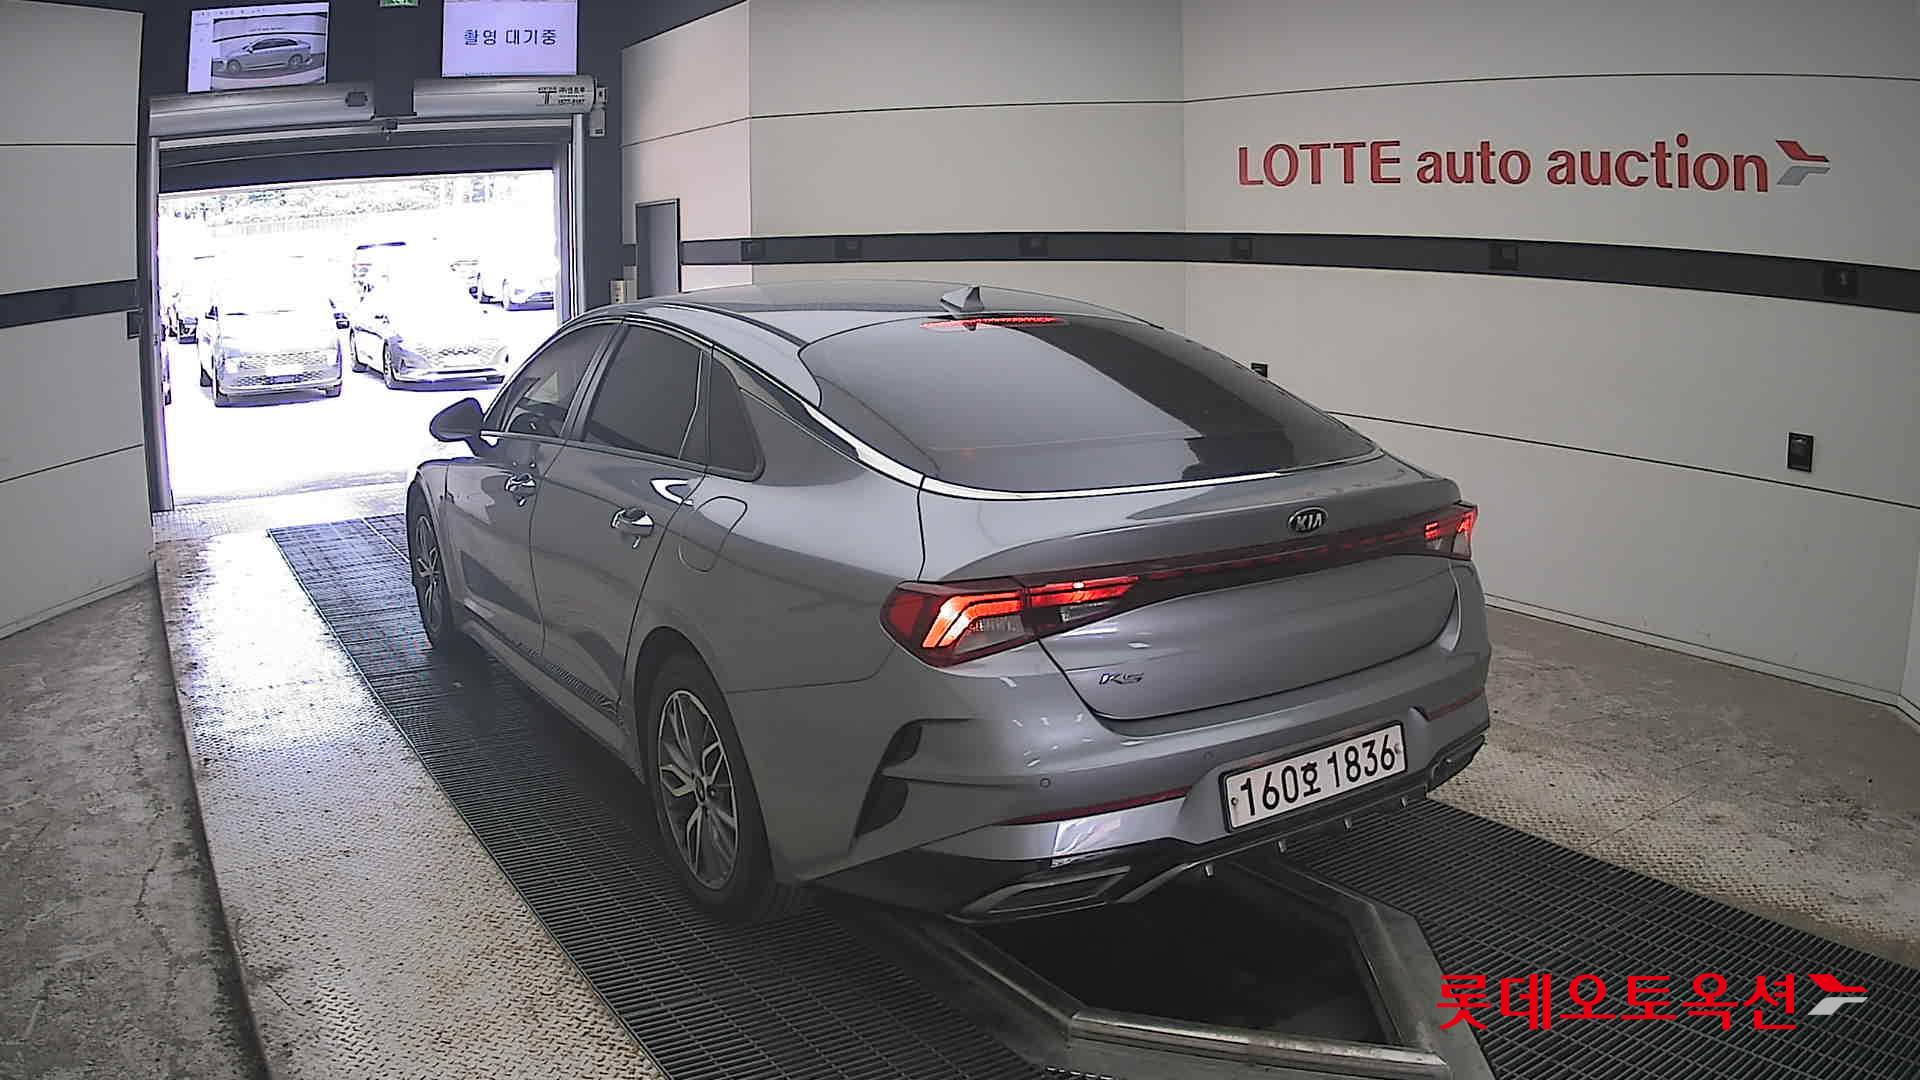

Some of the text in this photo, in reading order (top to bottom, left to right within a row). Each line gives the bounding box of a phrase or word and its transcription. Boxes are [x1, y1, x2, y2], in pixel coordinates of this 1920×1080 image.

[464, 29, 556, 45] 촬영 대기중
[1239, 133, 1768, 193] LOTTE auto auction
[1296, 512, 1322, 529] KIA
[1099, 672, 1144, 685] K5
[1240, 734, 1395, 816] 160호 1836
